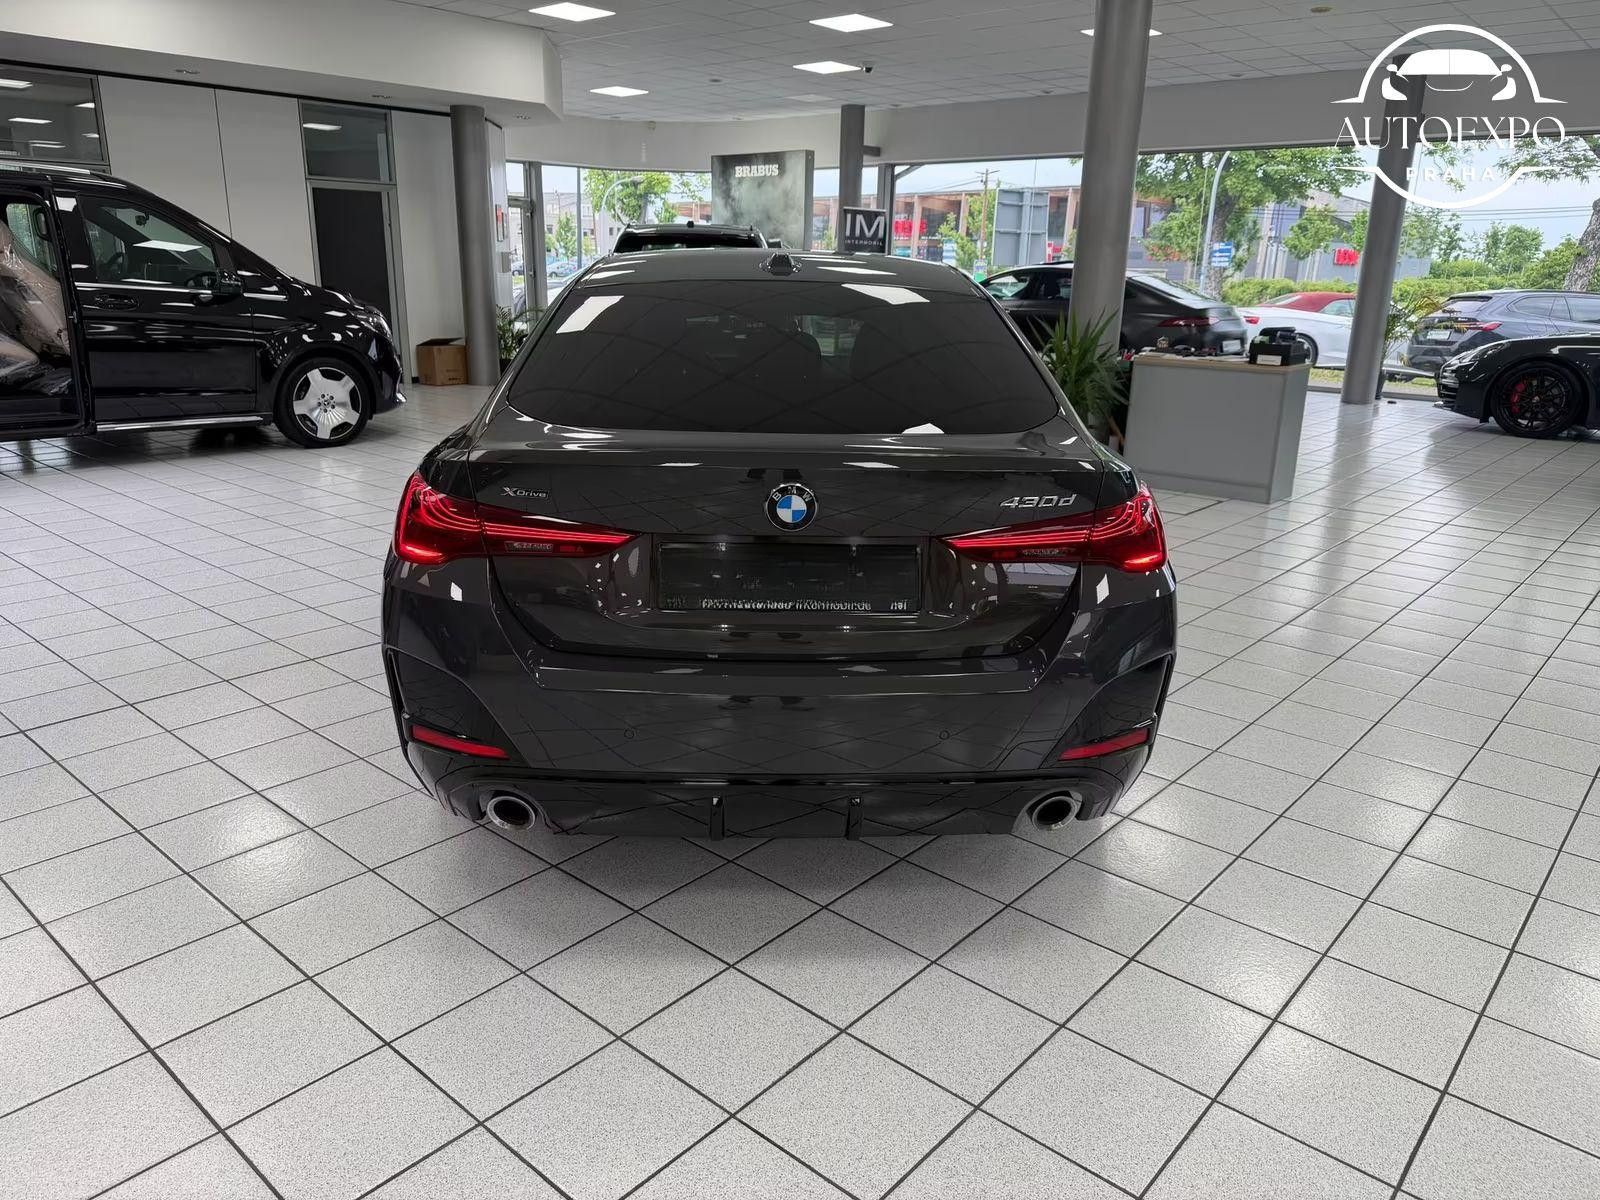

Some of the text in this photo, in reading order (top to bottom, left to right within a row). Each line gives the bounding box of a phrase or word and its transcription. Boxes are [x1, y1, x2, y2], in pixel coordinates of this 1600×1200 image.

[735, 163, 779, 178] BRABUS
[845, 213, 885, 239] IM
[1000, 493, 1077, 509] 430d
